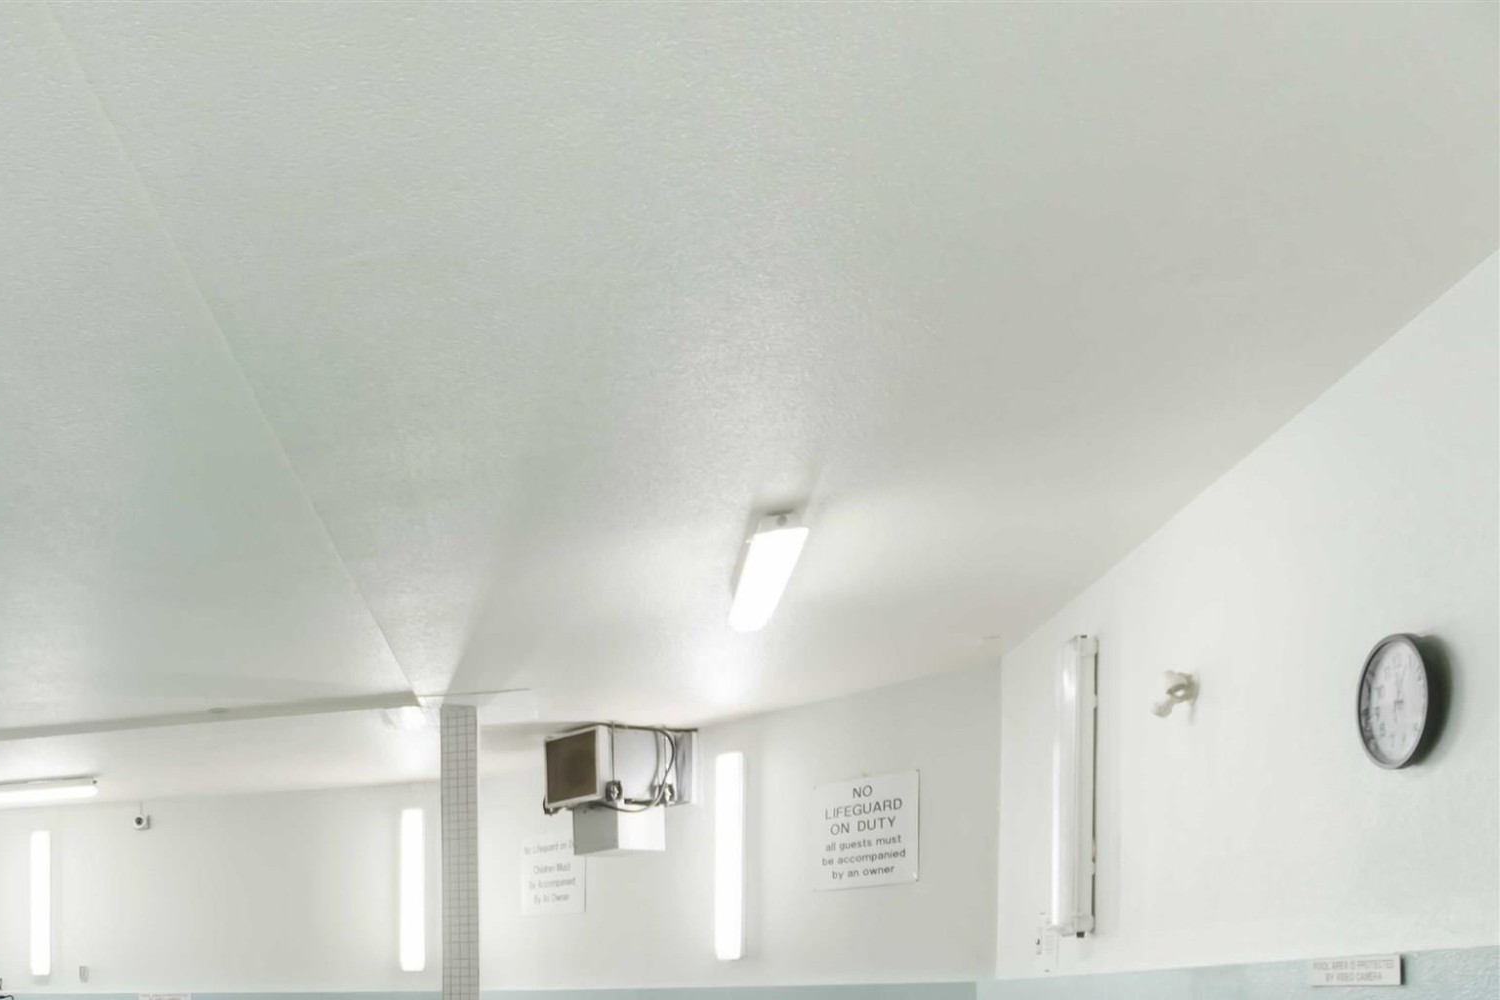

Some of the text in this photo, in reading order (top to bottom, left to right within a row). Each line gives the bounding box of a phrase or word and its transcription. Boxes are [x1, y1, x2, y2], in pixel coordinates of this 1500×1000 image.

[852, 785, 873, 798] NO
[825, 798, 903, 820] LIFEGUARD
[830, 816, 897, 835] ON DUTY
[826, 834, 902, 852] all guests must
[822, 849, 906, 866] be accompanied
[832, 865, 895, 880] by an owner
